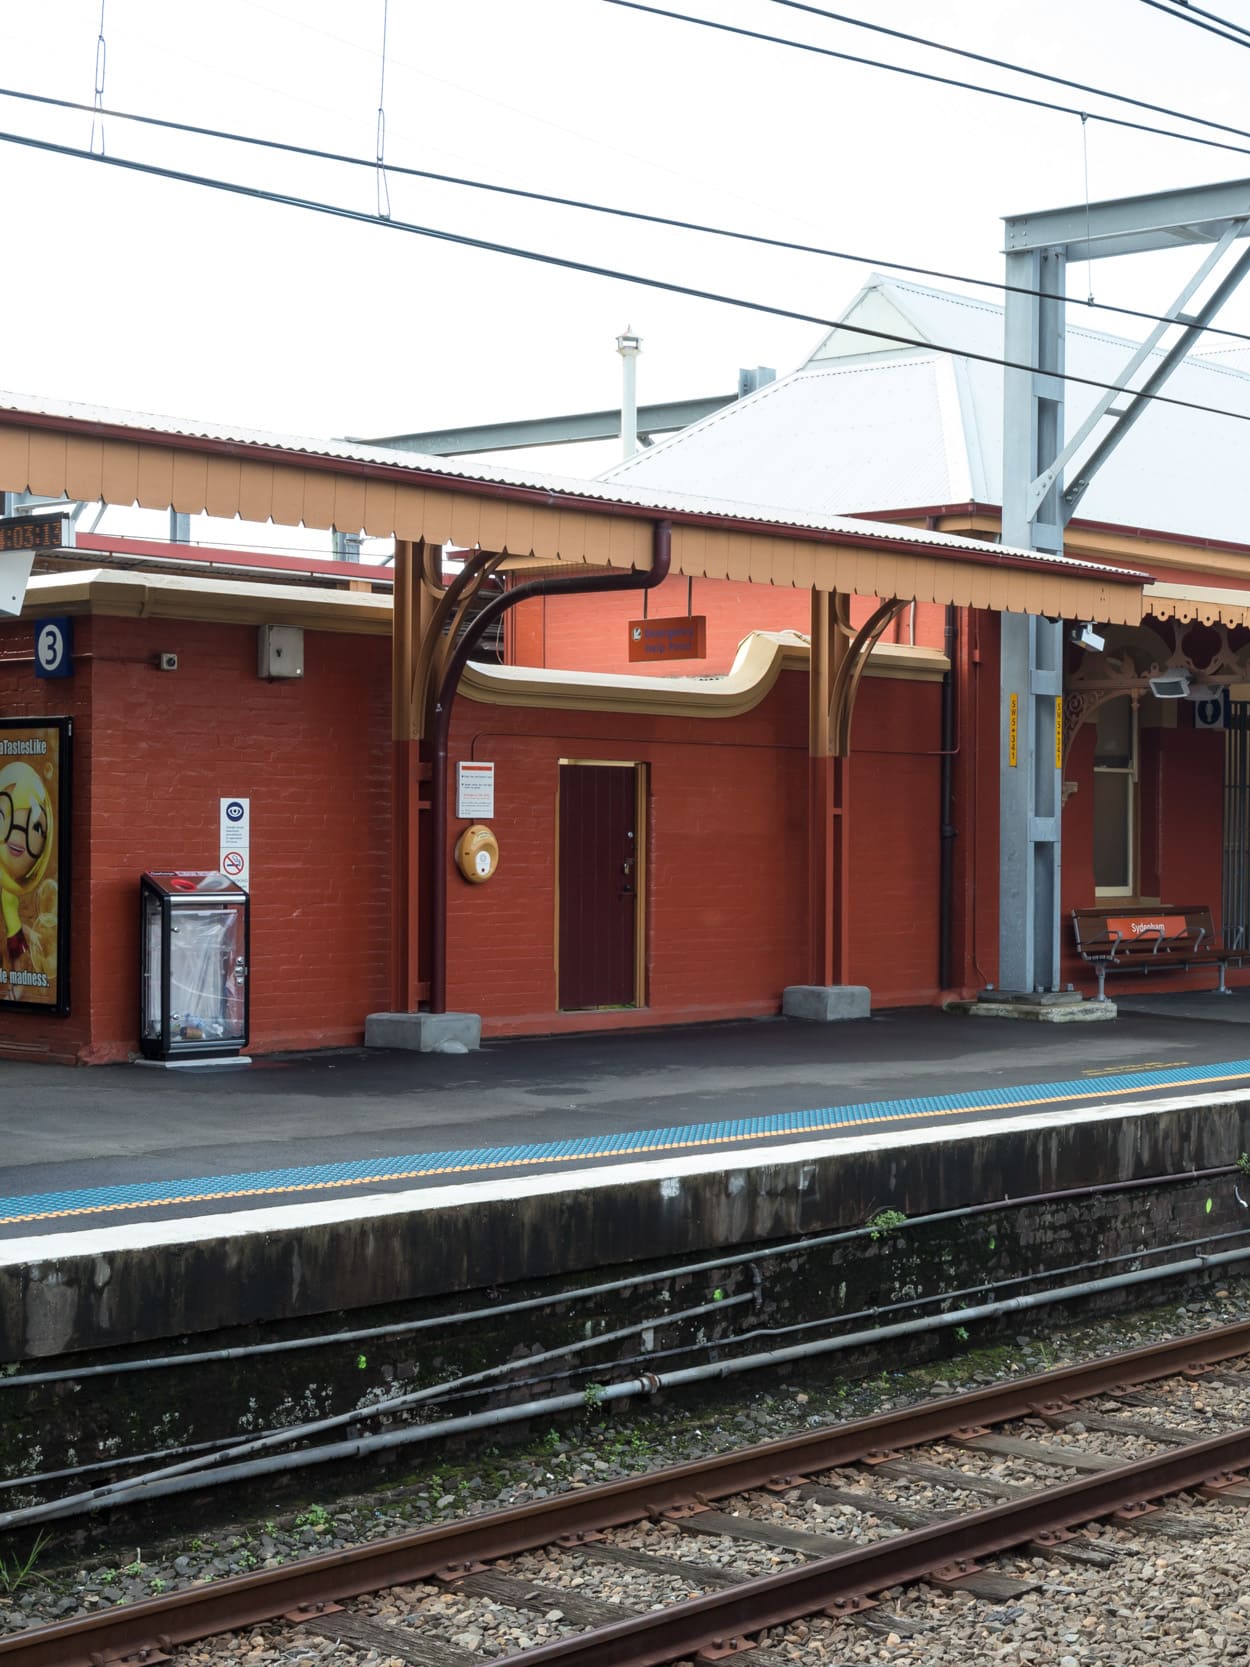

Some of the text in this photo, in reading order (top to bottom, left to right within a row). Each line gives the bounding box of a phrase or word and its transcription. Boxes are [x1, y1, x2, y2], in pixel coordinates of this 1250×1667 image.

[45, 630, 57, 666] 3
[1130, 922, 1166, 935] Sydenham
[9, 969, 50, 988] madness.
